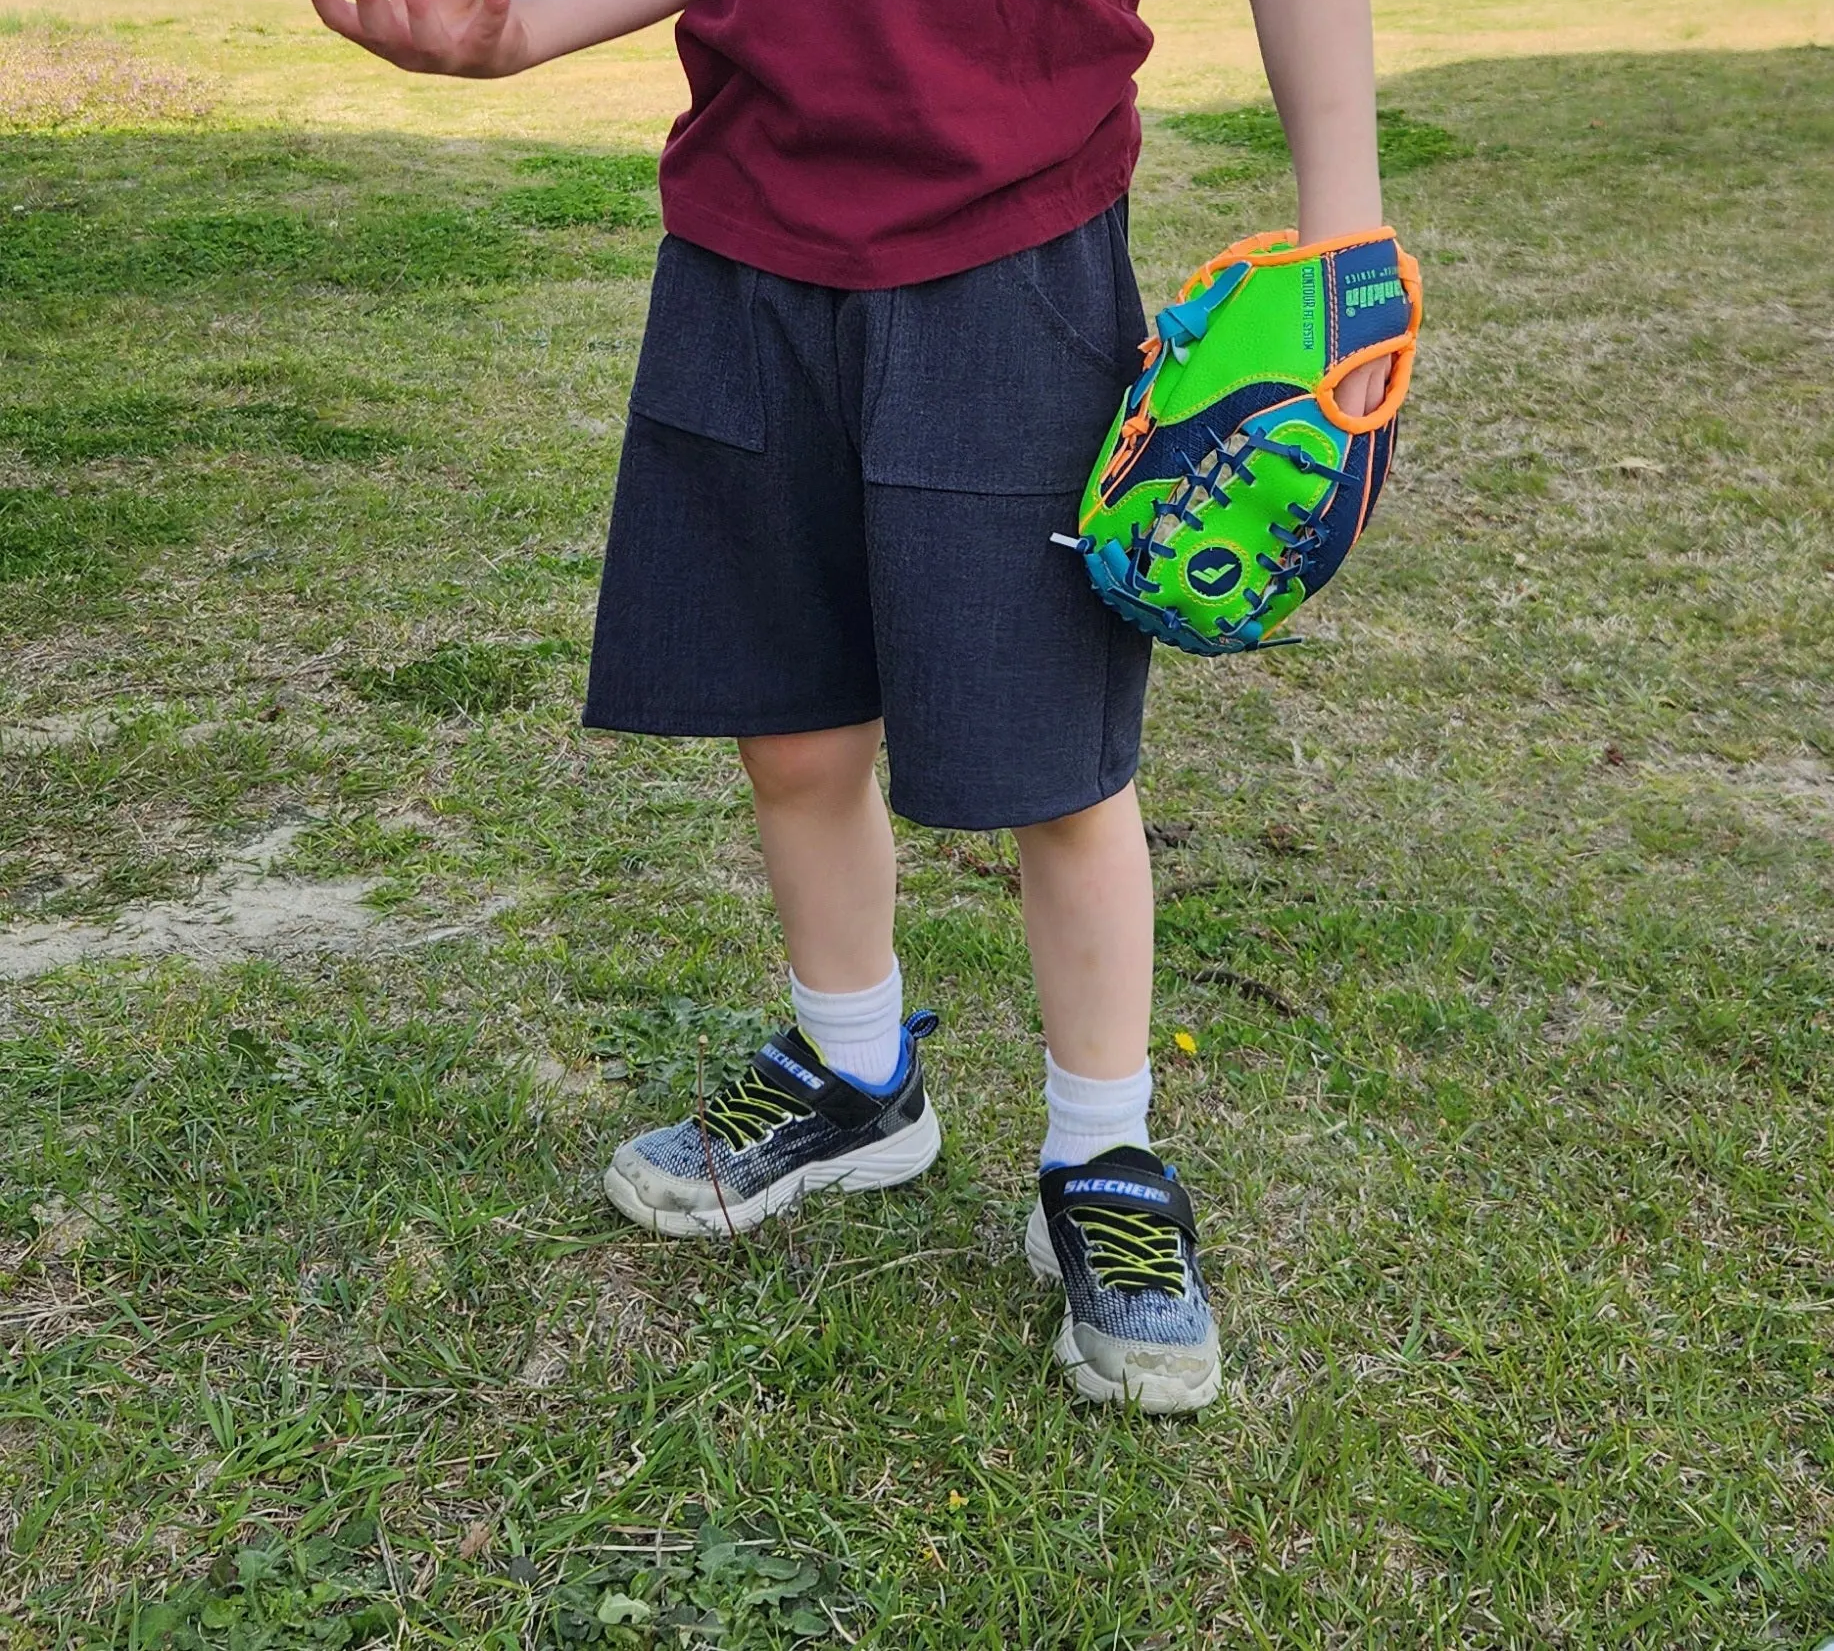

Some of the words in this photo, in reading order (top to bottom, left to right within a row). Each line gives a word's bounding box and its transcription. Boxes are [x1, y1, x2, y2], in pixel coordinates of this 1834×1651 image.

[1302, 266, 1316, 308] CONTOUR
[1345, 279, 1406, 309] anklin
[1303, 322, 1314, 350] SYSTEM
[1063, 1178, 1171, 1205] SKECHERS
